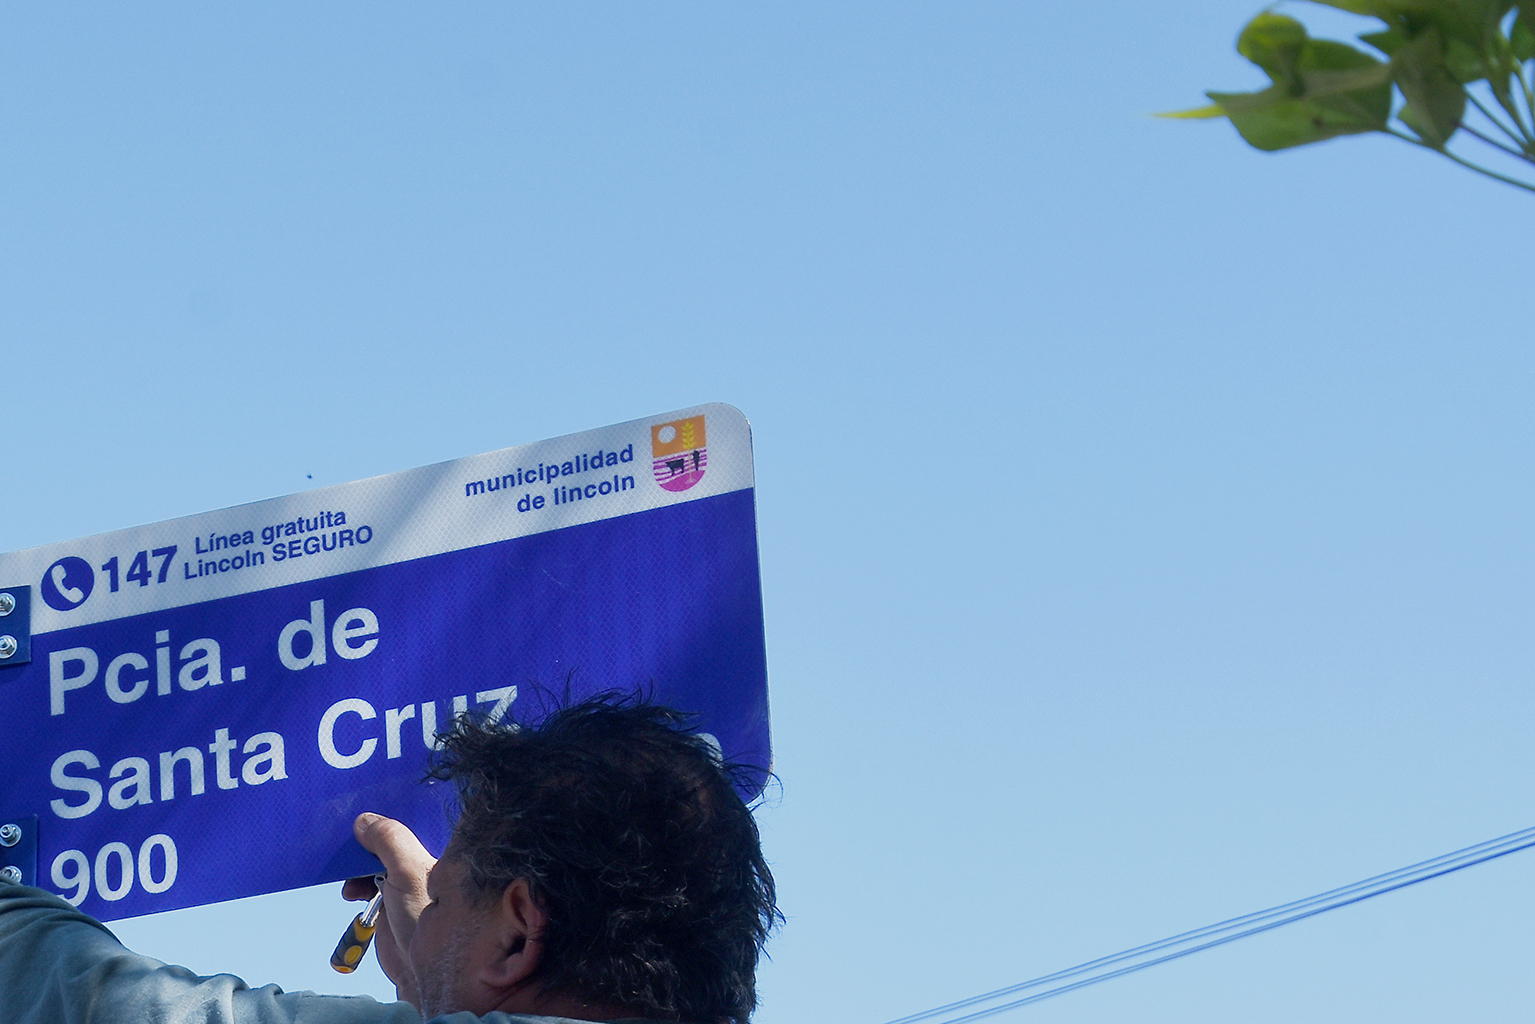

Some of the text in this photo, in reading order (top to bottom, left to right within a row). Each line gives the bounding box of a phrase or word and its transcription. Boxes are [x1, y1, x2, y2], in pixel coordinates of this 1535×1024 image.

[465, 444, 634, 497] municipalidad
[517, 475, 635, 513] de lincoln
[184, 525, 373, 580] Lincoln SEGURO
[195, 511, 347, 554] Línea gratuita
[101, 545, 178, 593] 147
[49, 599, 380, 716] Pcia. de
[50, 685, 521, 819] Santa Cruz
[50, 833, 179, 908] 900
